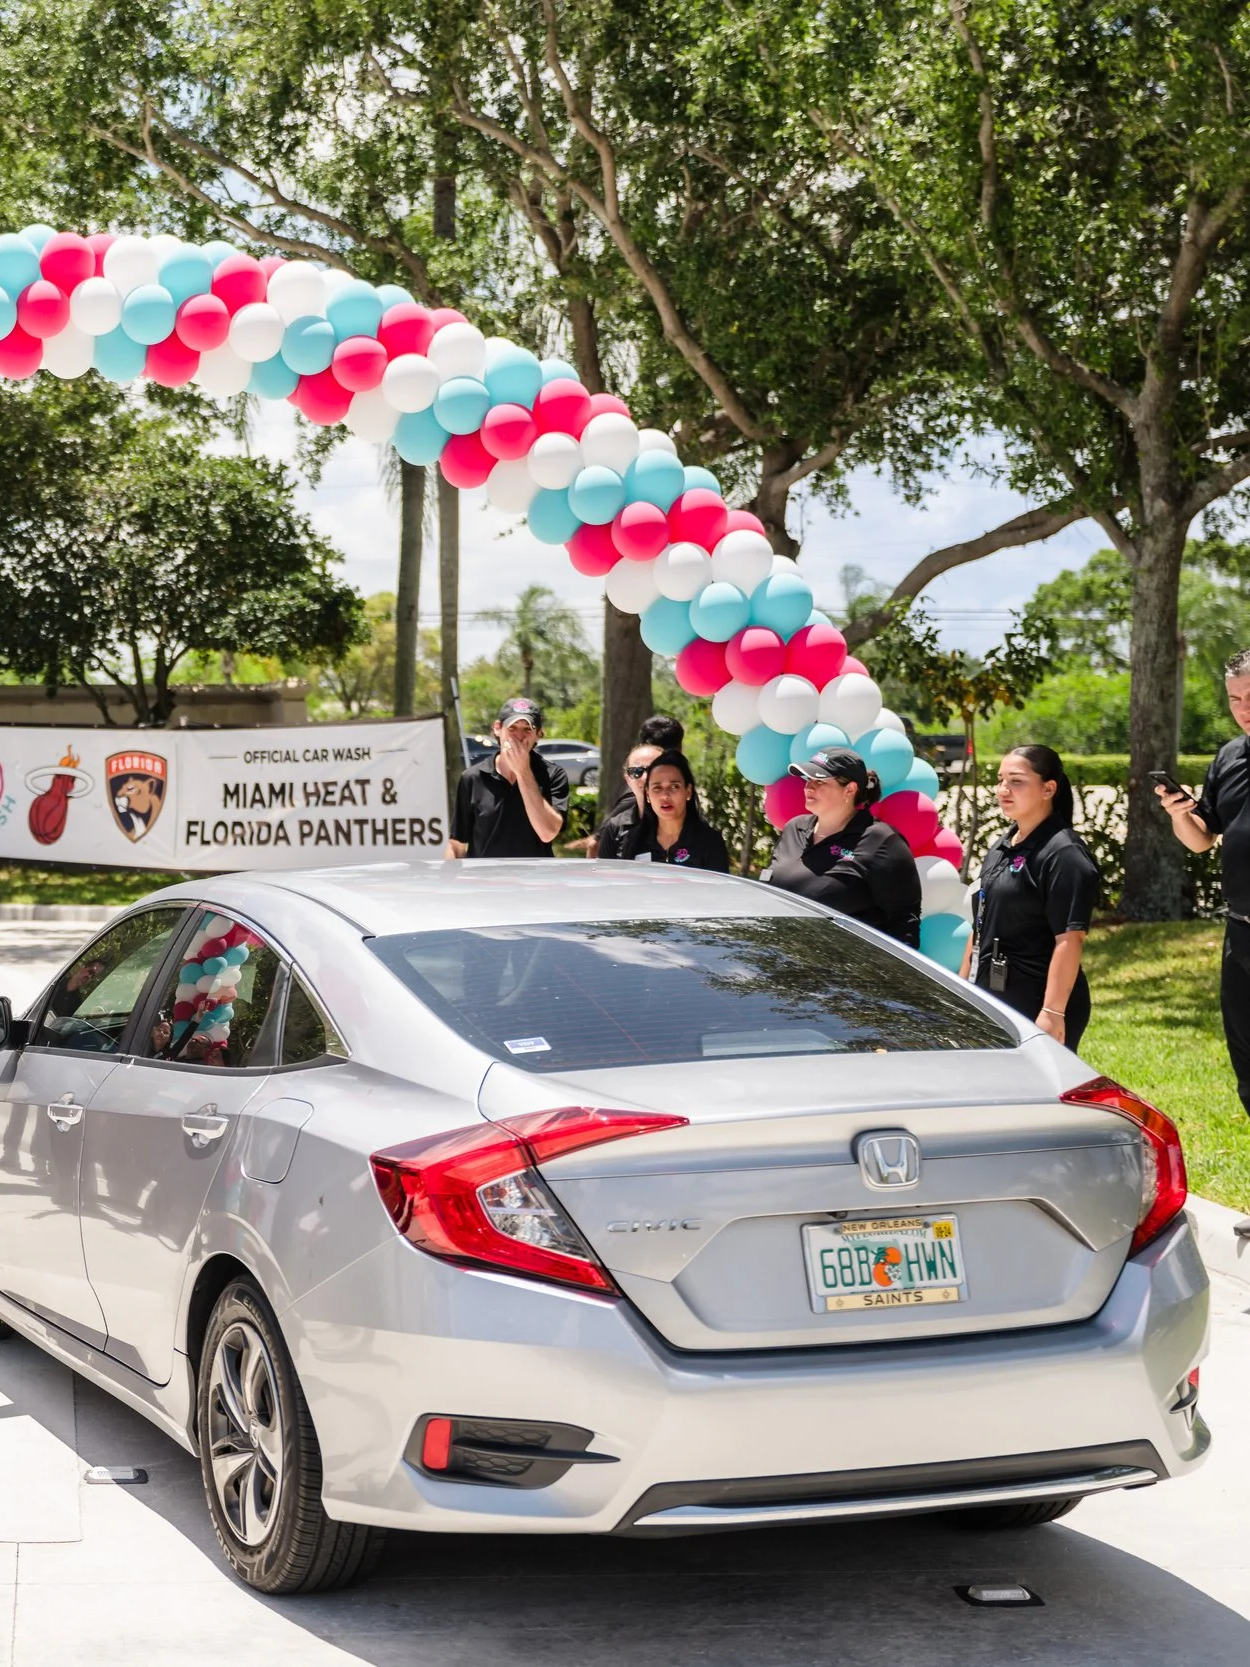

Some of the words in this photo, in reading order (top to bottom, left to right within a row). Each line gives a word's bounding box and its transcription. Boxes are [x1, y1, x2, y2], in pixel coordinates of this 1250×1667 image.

[243, 749, 300, 764] OFFICIAL
[302, 748, 329, 763] CAR
[332, 747, 372, 762] WASH
[110, 757, 163, 776] FLORIDA
[222, 781, 296, 809] MIAMI
[302, 778, 371, 807] HEAT
[380, 776, 398, 806] &
[185, 820, 291, 847] FLORIDA
[299, 817, 444, 847] PANTHERS
[606, 1217, 703, 1232] CIVIC
[843, 1221, 868, 1231] NEW
[872, 1219, 922, 1230] ORLEANS
[819, 1247, 874, 1288] 68B
[903, 1240, 957, 1283] HWN
[863, 1291, 924, 1306] SAINTS
